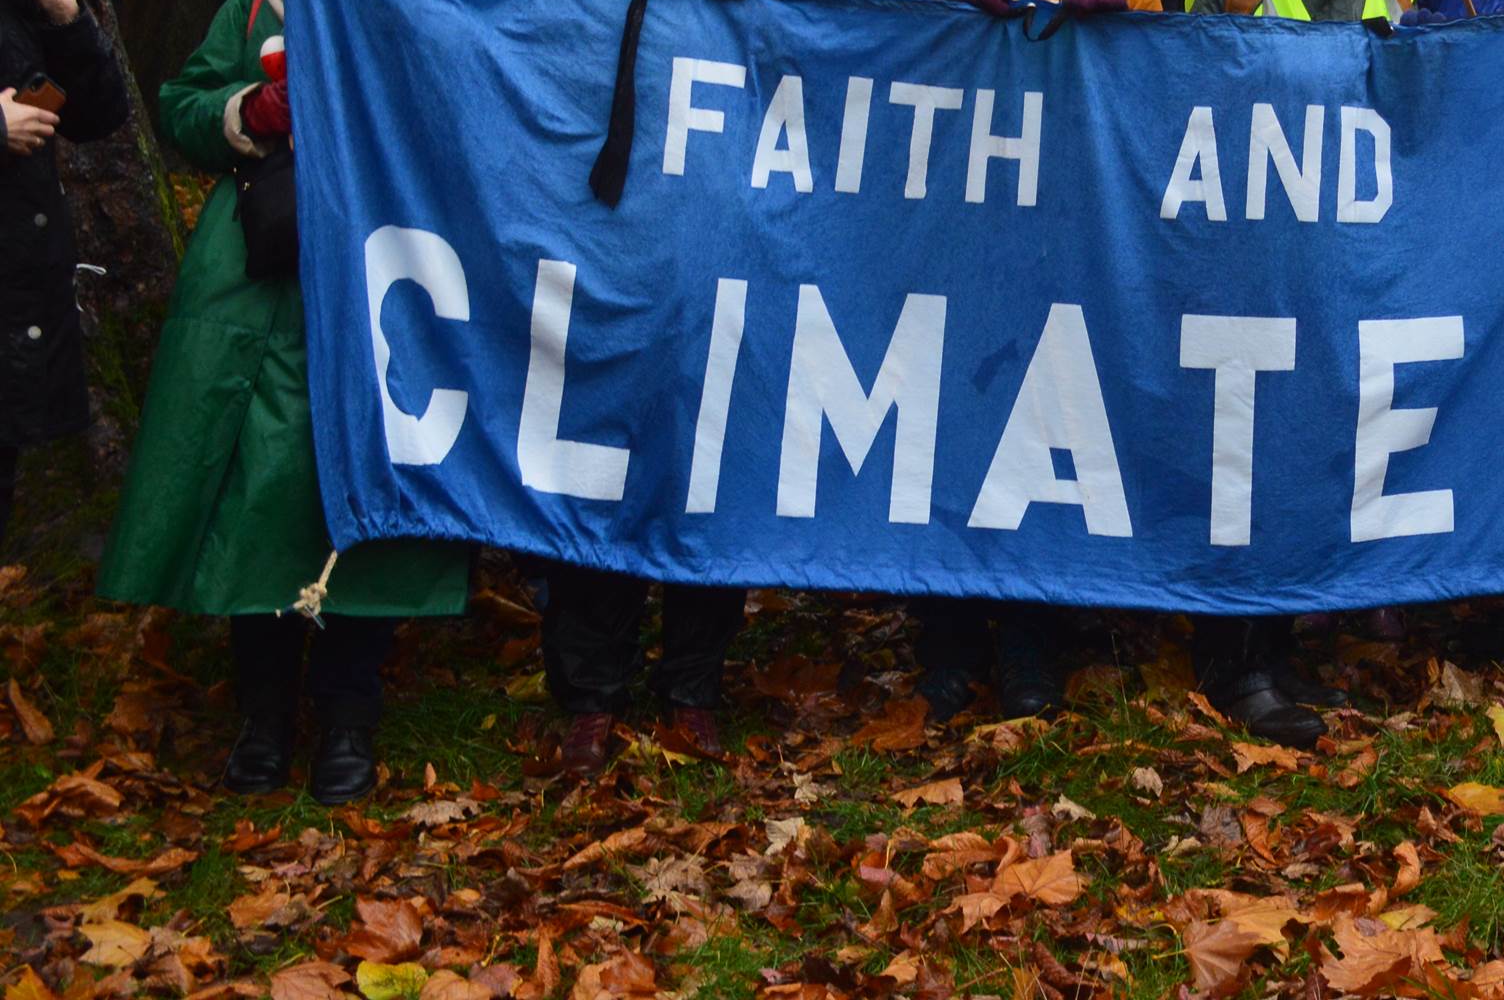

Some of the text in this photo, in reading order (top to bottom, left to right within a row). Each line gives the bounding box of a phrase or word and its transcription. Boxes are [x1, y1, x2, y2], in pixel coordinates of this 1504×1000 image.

[662, 56, 1043, 207] FAITH
[1160, 103, 1394, 223] AND
[365, 225, 1464, 546] CLIMATE
